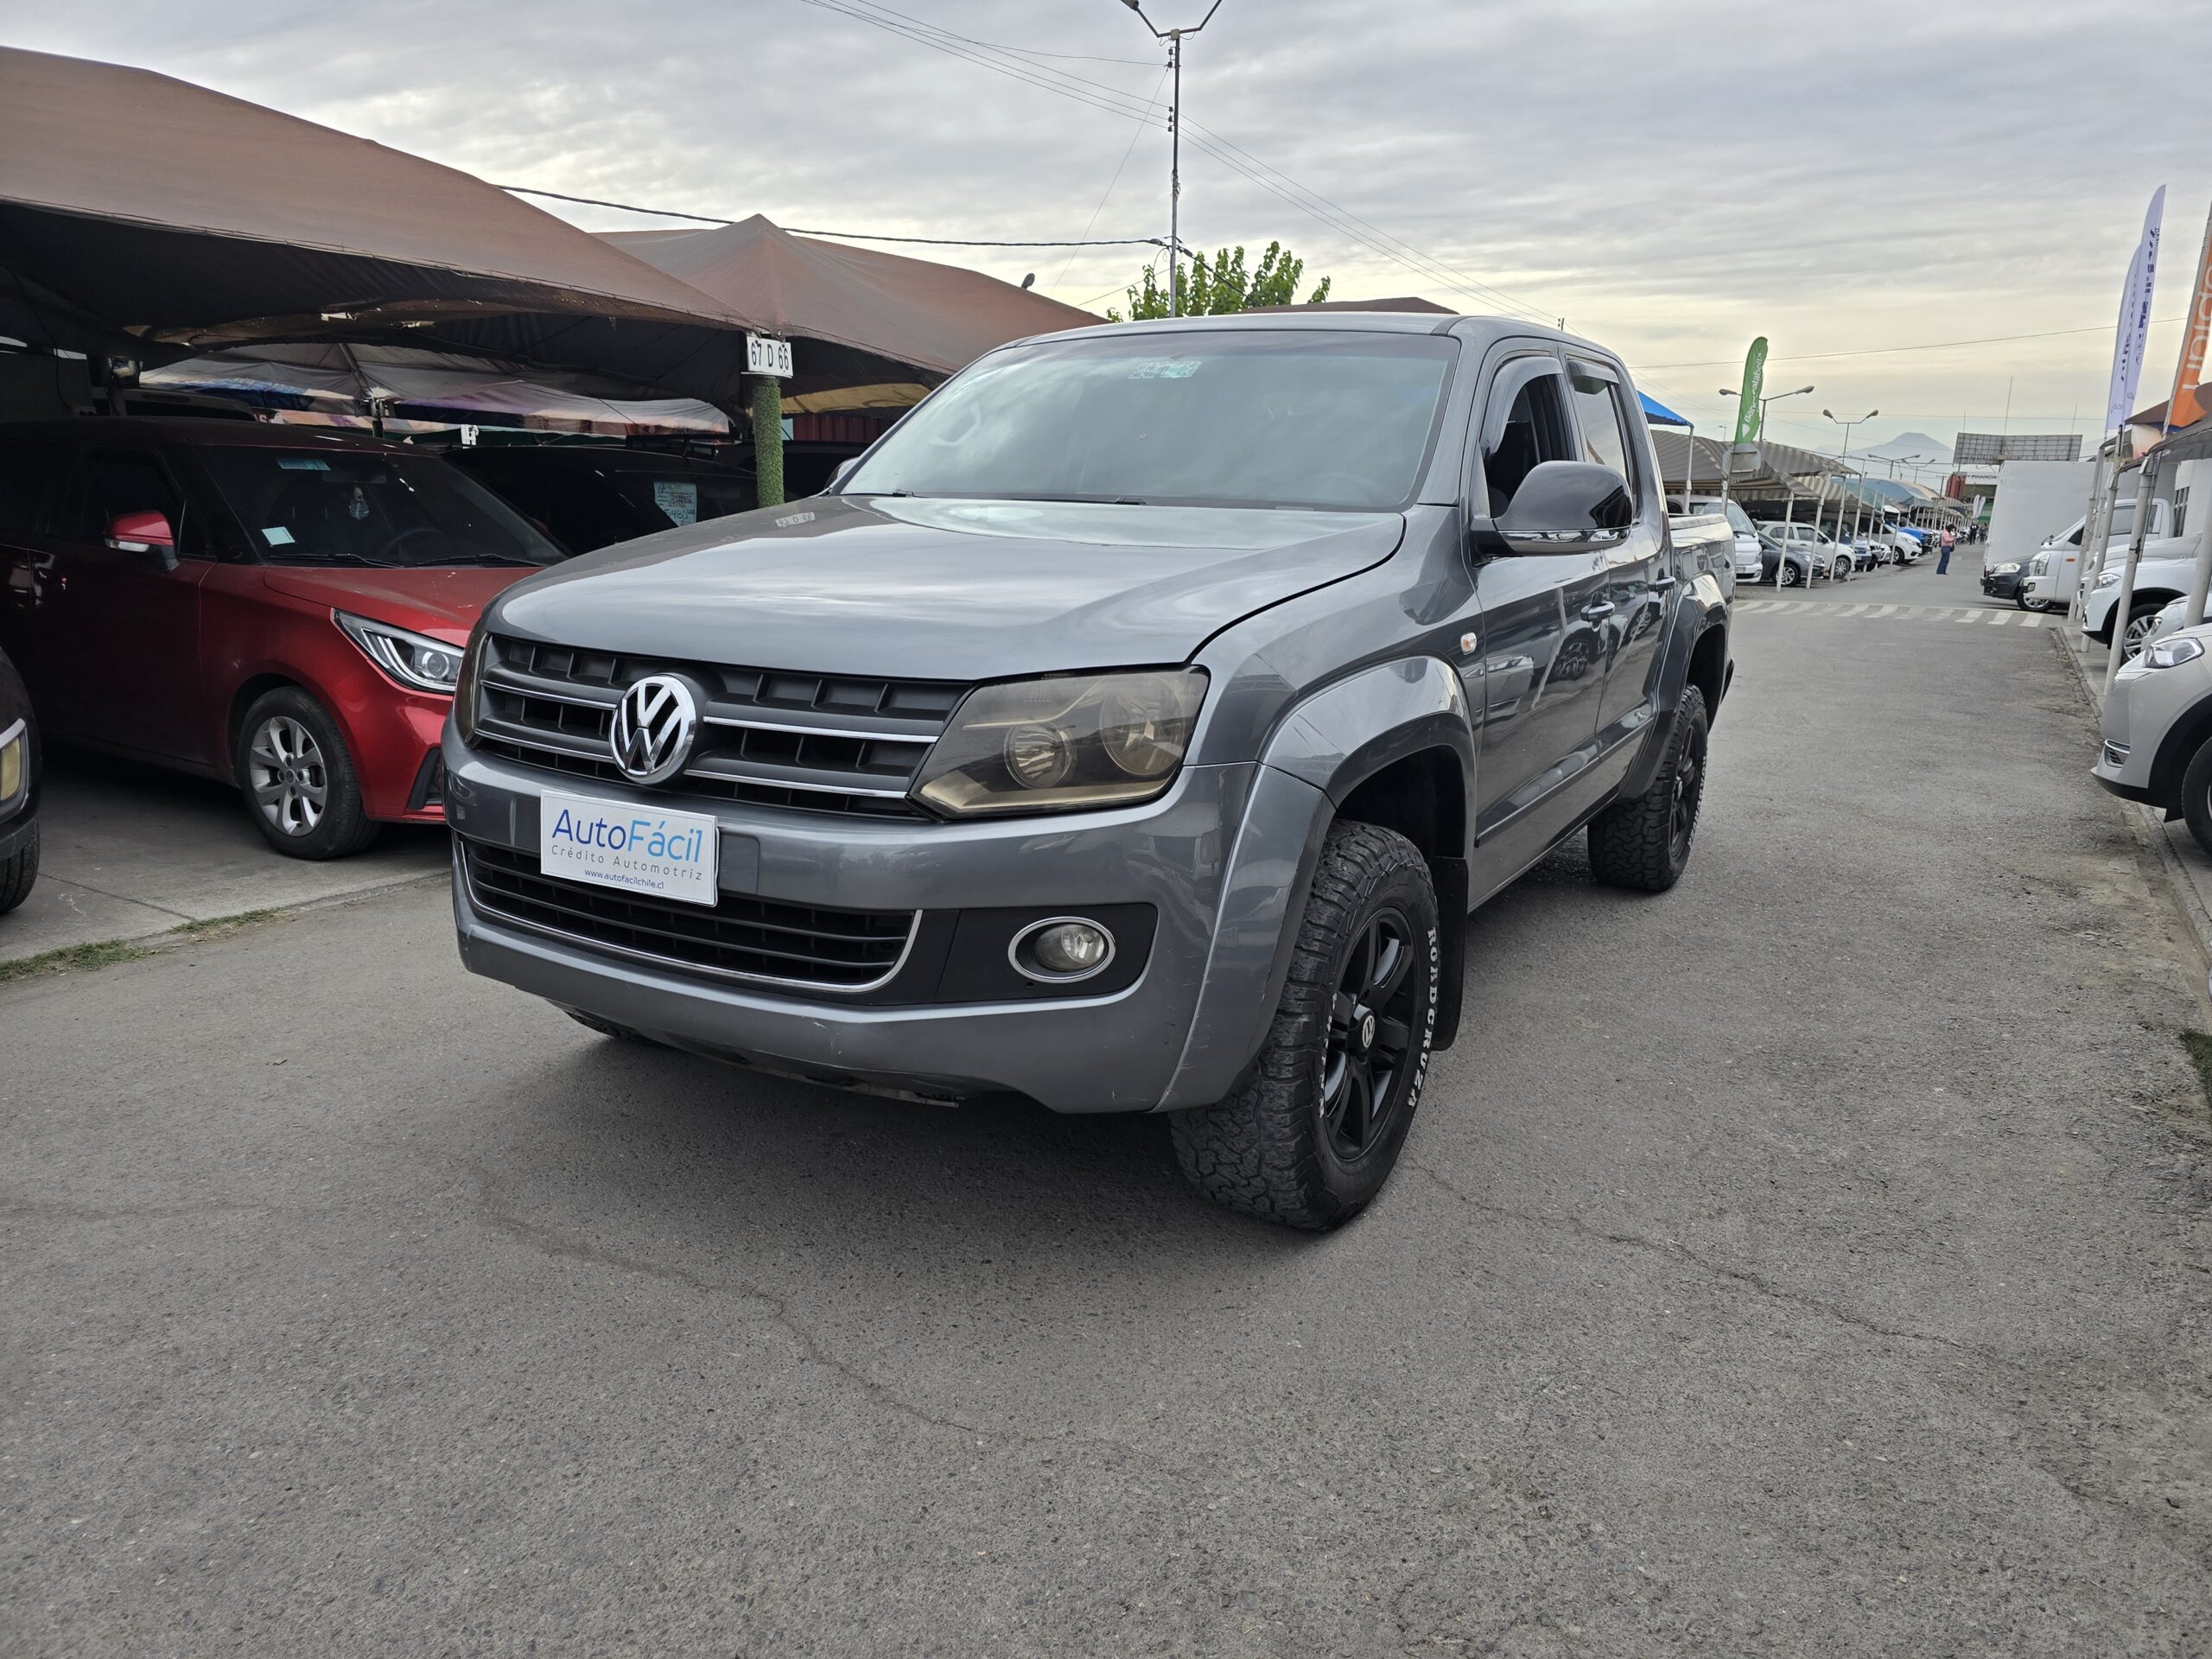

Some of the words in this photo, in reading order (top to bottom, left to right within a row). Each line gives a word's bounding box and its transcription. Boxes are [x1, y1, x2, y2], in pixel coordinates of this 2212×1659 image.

[750, 341, 762, 366] 67
[766, 343, 774, 368] D
[778, 346, 790, 371] 66
[551, 809, 703, 863] AutoFácil
[551, 844, 605, 864] Crédito
[613, 855, 702, 881] Automotriz
[584, 868, 664, 890] www.autofacilchile.cl
[1408, 926, 1439, 1108] ROADCRUZA
